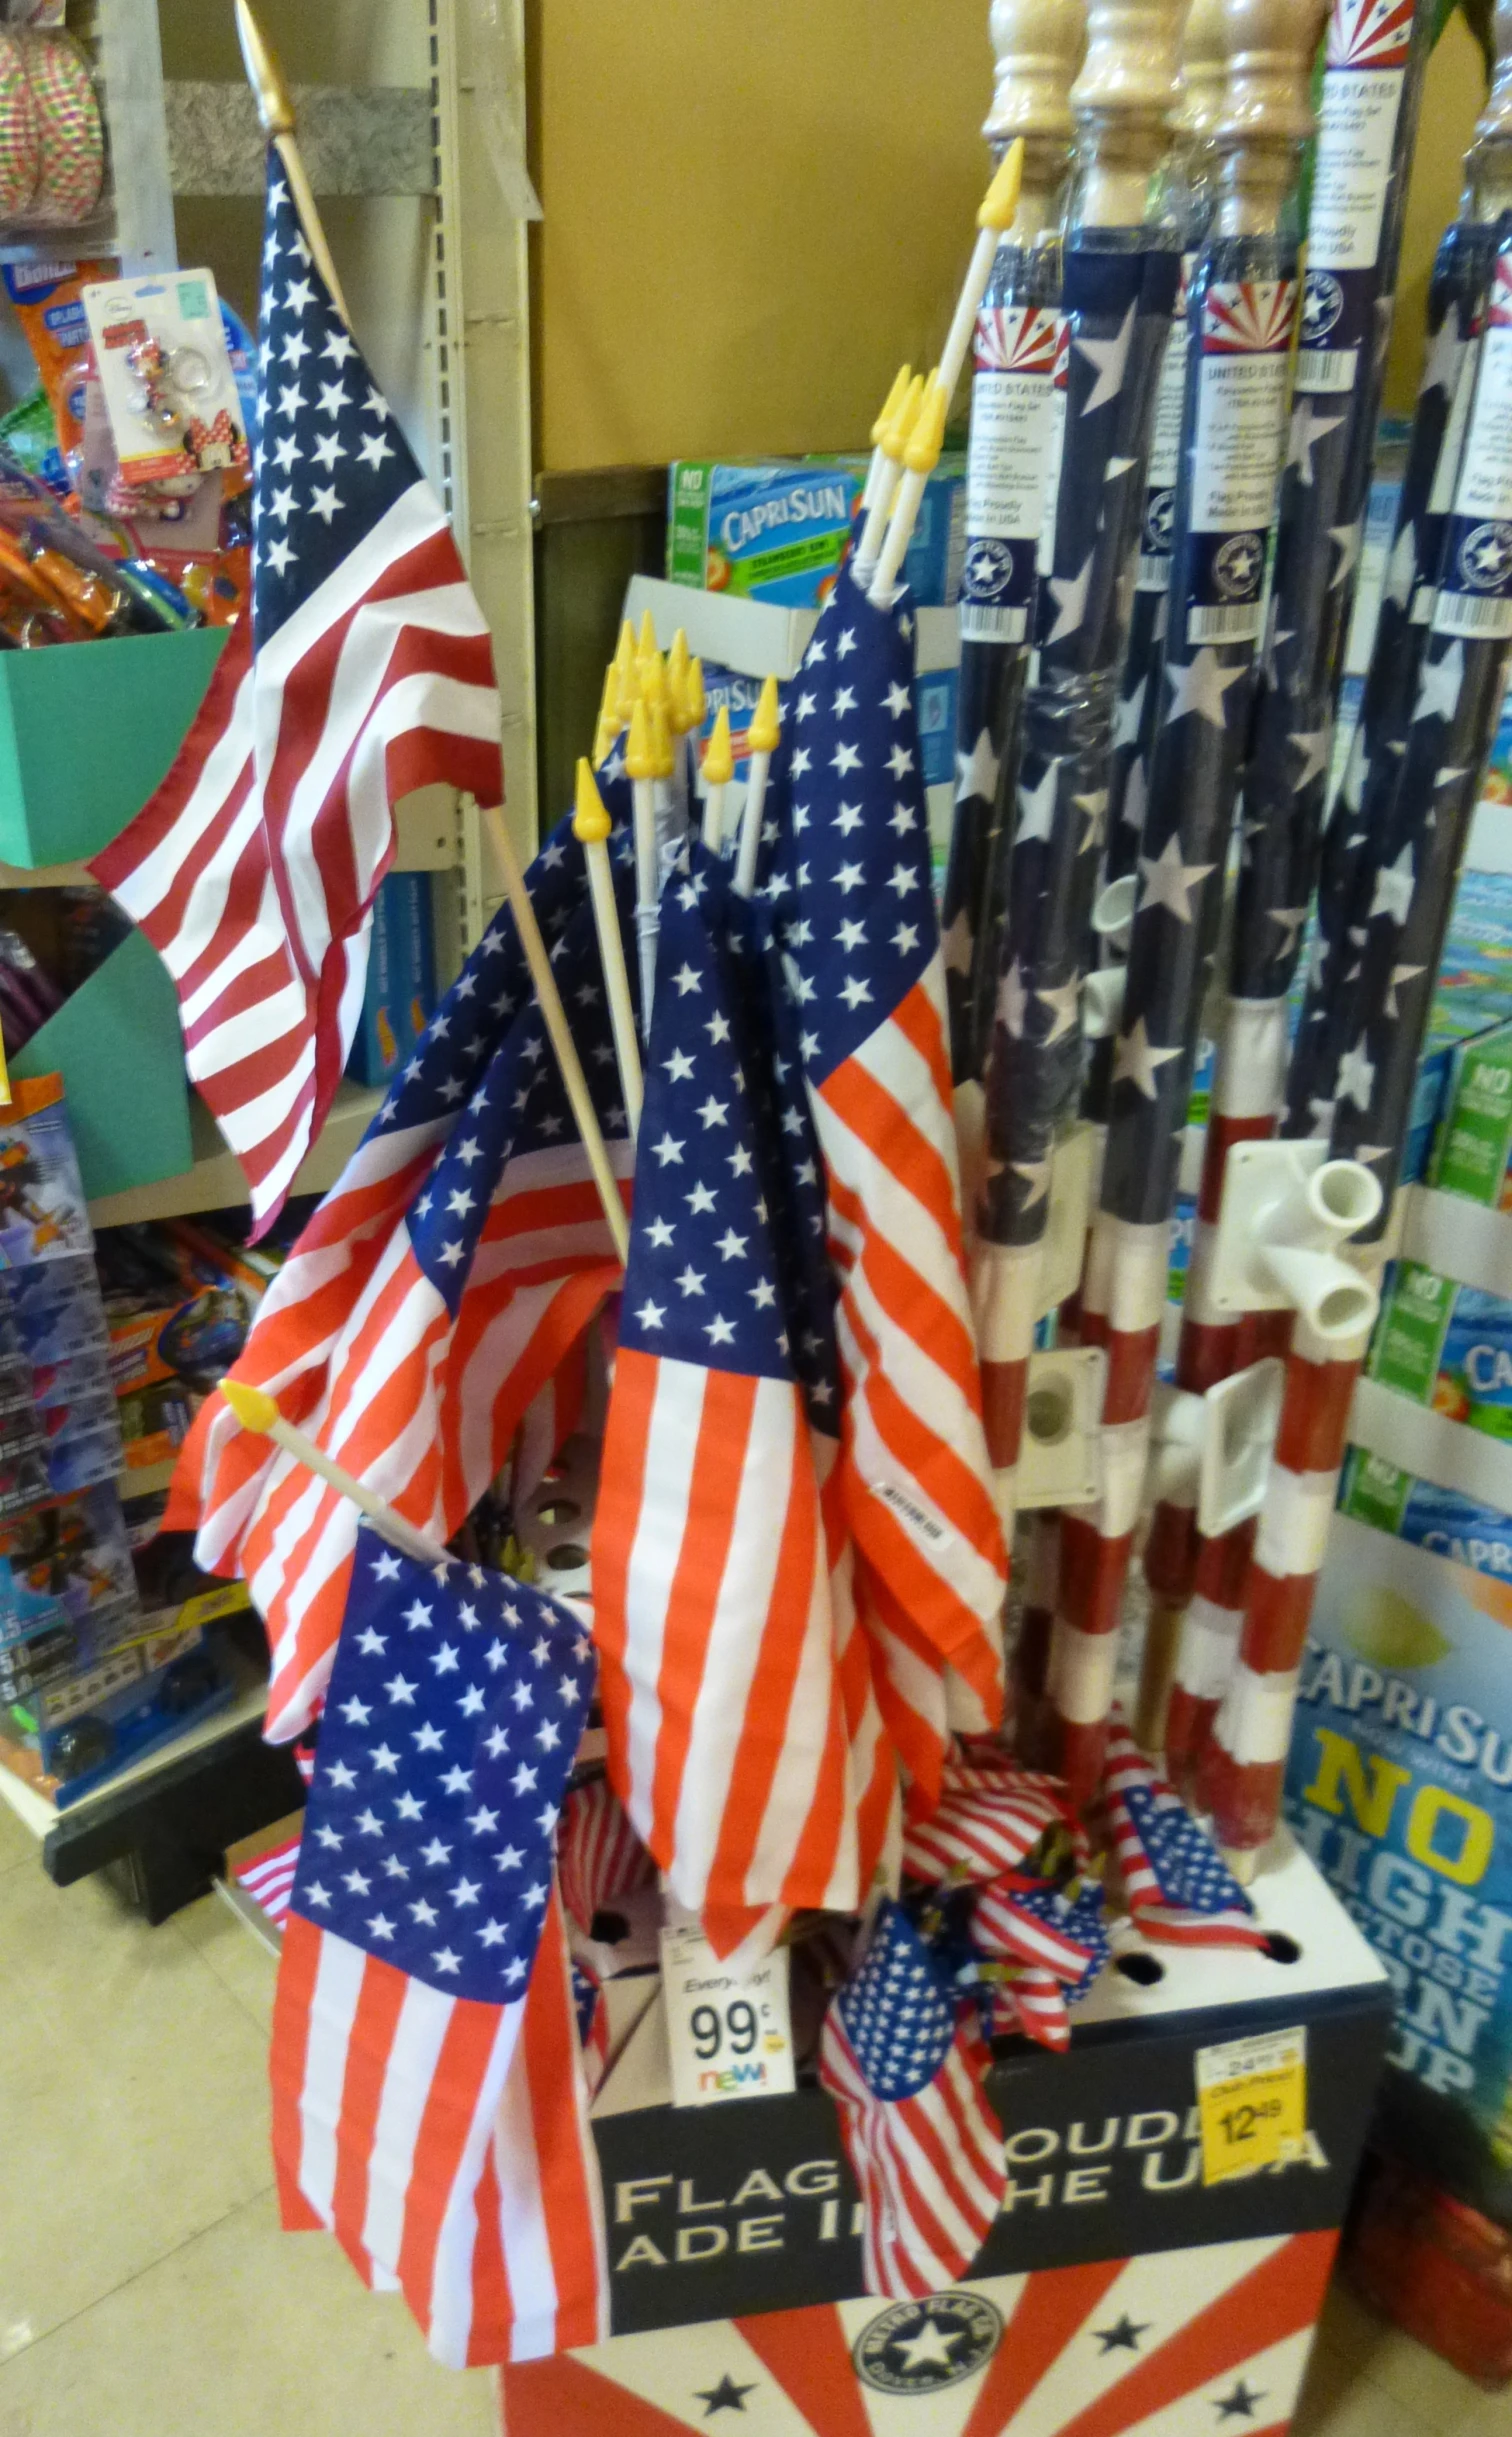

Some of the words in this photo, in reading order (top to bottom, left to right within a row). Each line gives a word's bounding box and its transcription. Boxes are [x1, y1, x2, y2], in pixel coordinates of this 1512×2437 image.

[1303, 1726, 1494, 1886] NO
[698, 2060, 768, 2092] new!
[614, 2160, 840, 2223] FLAG
[614, 2213, 786, 2272] ADE
[1002, 2164, 1113, 2213] HE
